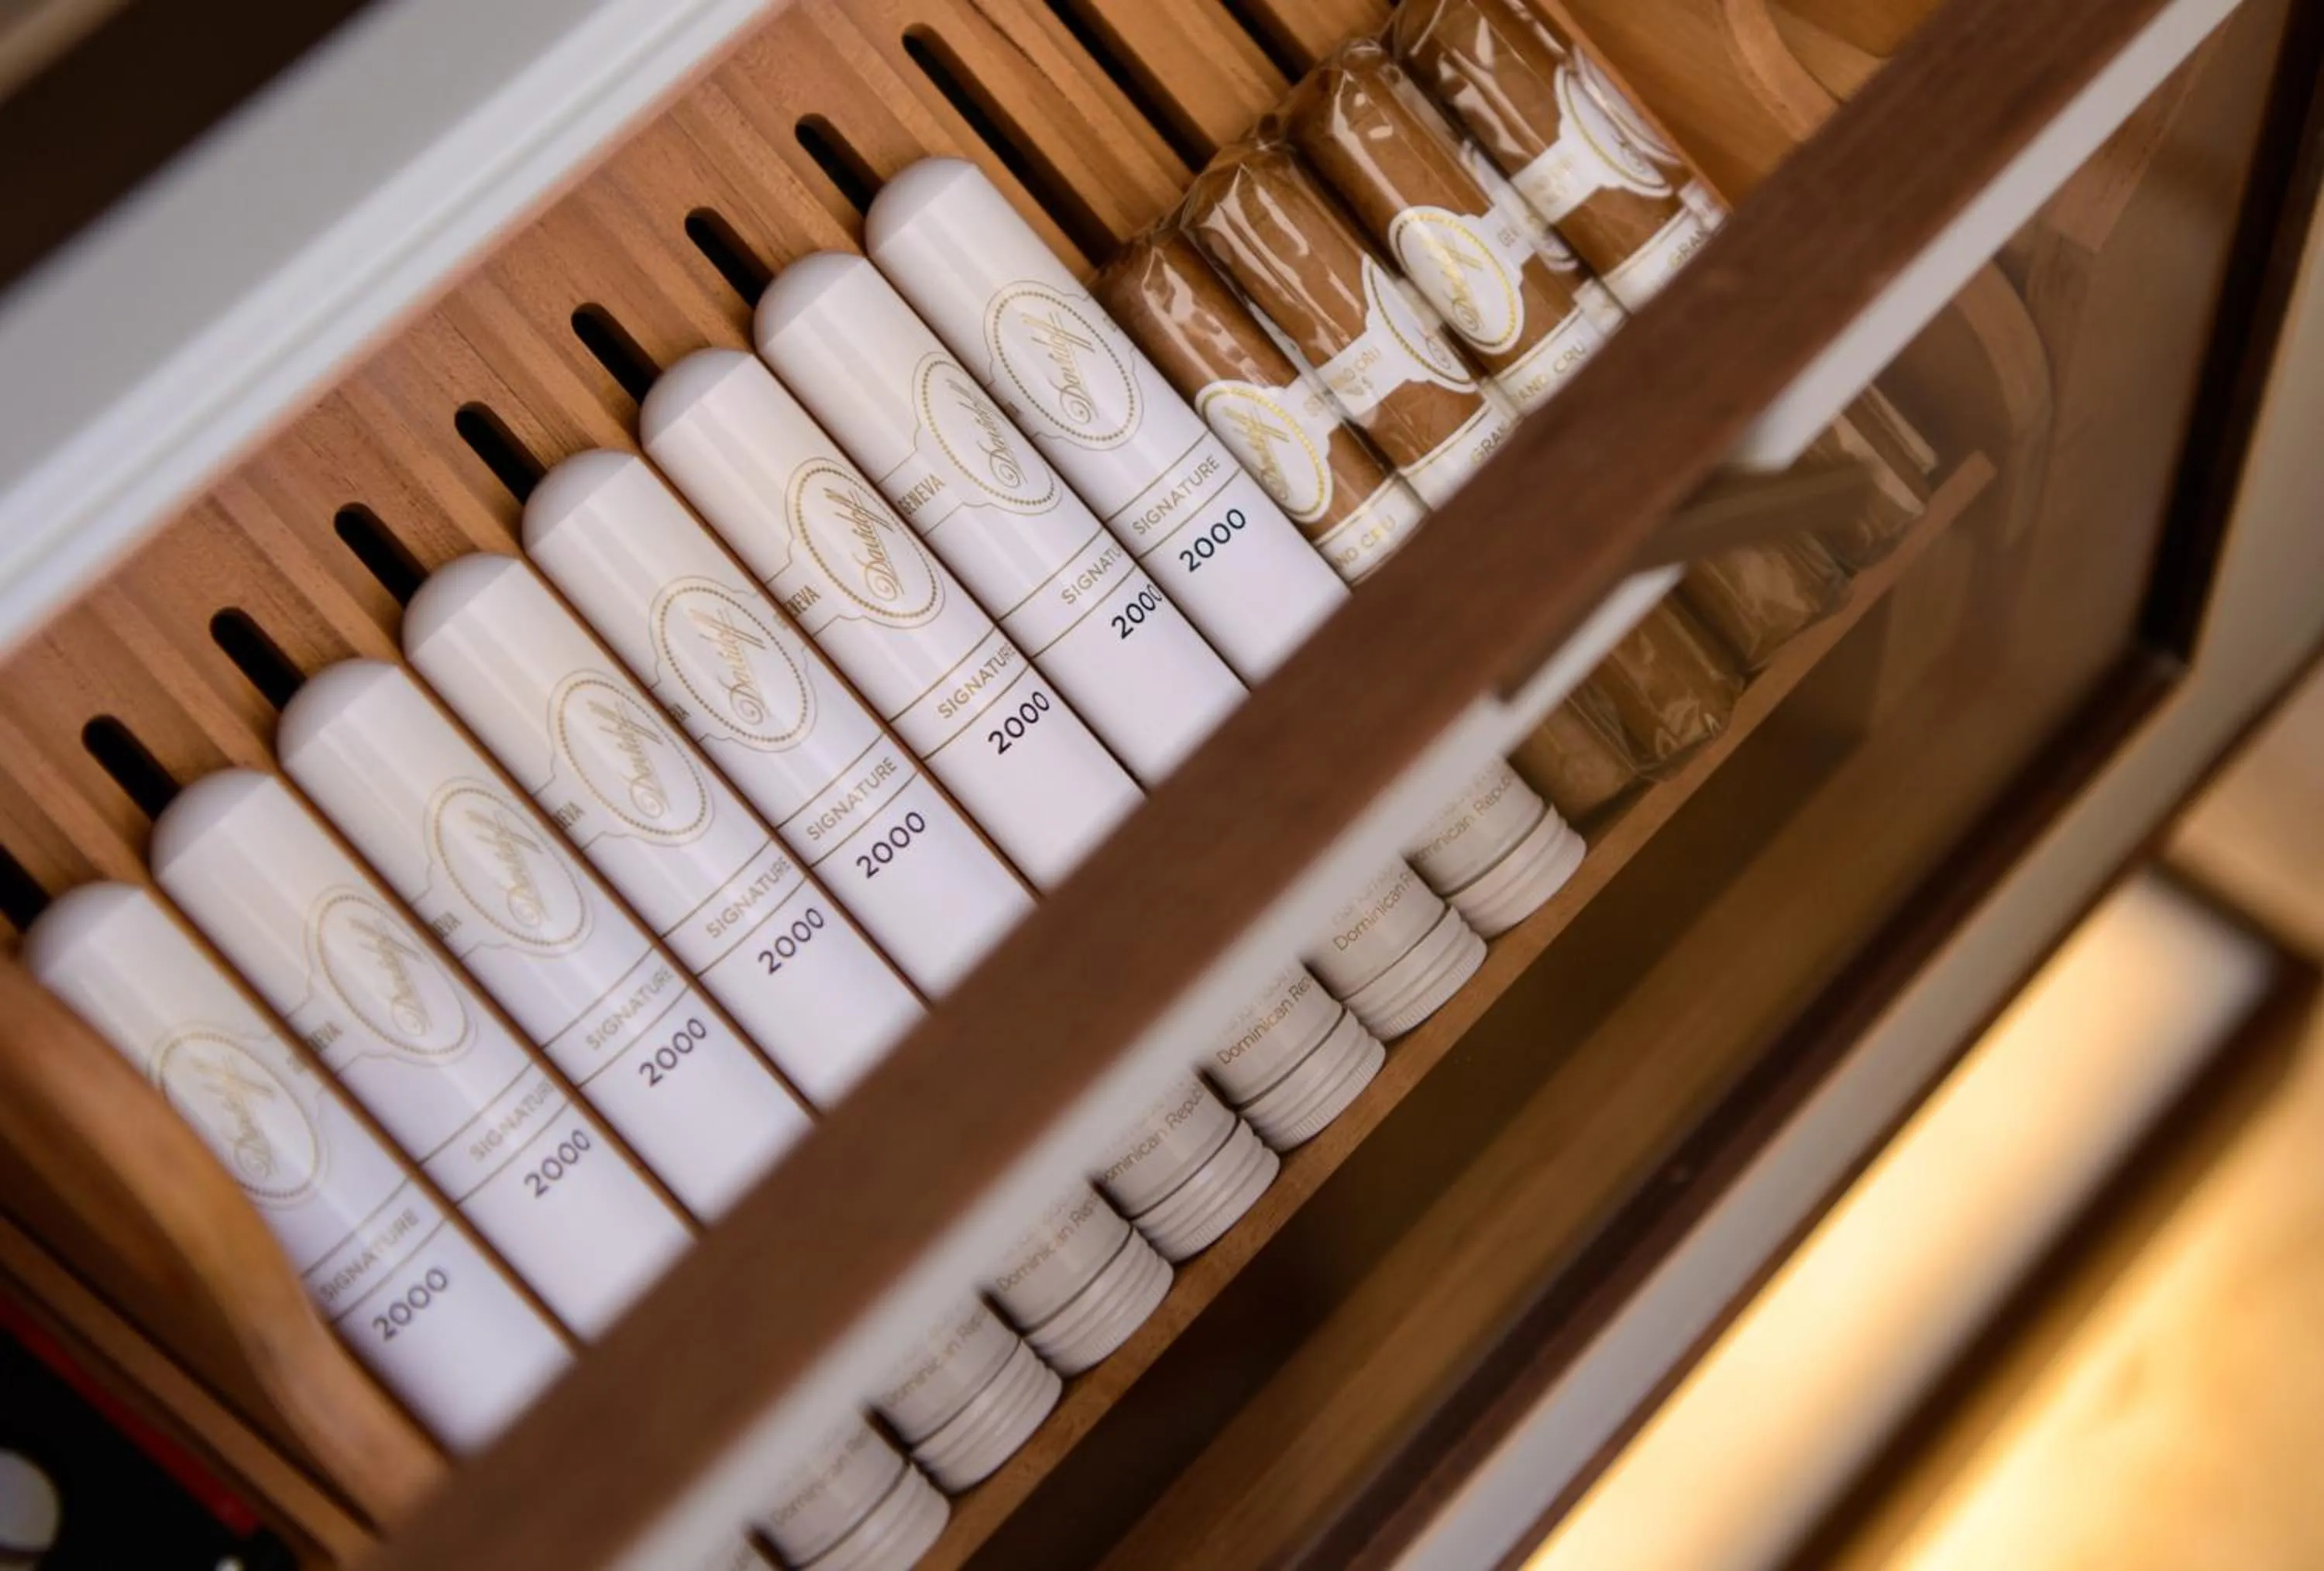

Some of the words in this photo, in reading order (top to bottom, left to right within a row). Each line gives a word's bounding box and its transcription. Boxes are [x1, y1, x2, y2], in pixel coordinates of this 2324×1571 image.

[1020, 311, 1099, 425] Davidoff
[1132, 455, 1221, 535] SIGNATURE
[822, 486, 906, 601] Davidoff
[1061, 543, 1122, 605] SIGNATU
[1179, 507, 1247, 572] 2000
[1111, 583, 1164, 638] 2000
[685, 608, 771, 726] Davidoff
[988, 691, 1051, 755] 2000
[806, 756, 898, 841] SIGNATURE
[856, 811, 927, 879] 2000
[1414, 815, 1475, 861] ominican
[705, 855, 792, 939] SIGNATURE
[1332, 882, 1408, 951] Dominican
[757, 907, 825, 975] 2000
[586, 968, 674, 1052] SIGNATURE
[1215, 999, 1294, 1065] Dominican
[638, 1017, 708, 1086] 2000
[523, 1128, 593, 1198] 2000
[1104, 1128, 1168, 1181] ominican
[318, 1208, 420, 1302] SIGNATURE
[372, 1267, 450, 1342] 2000
